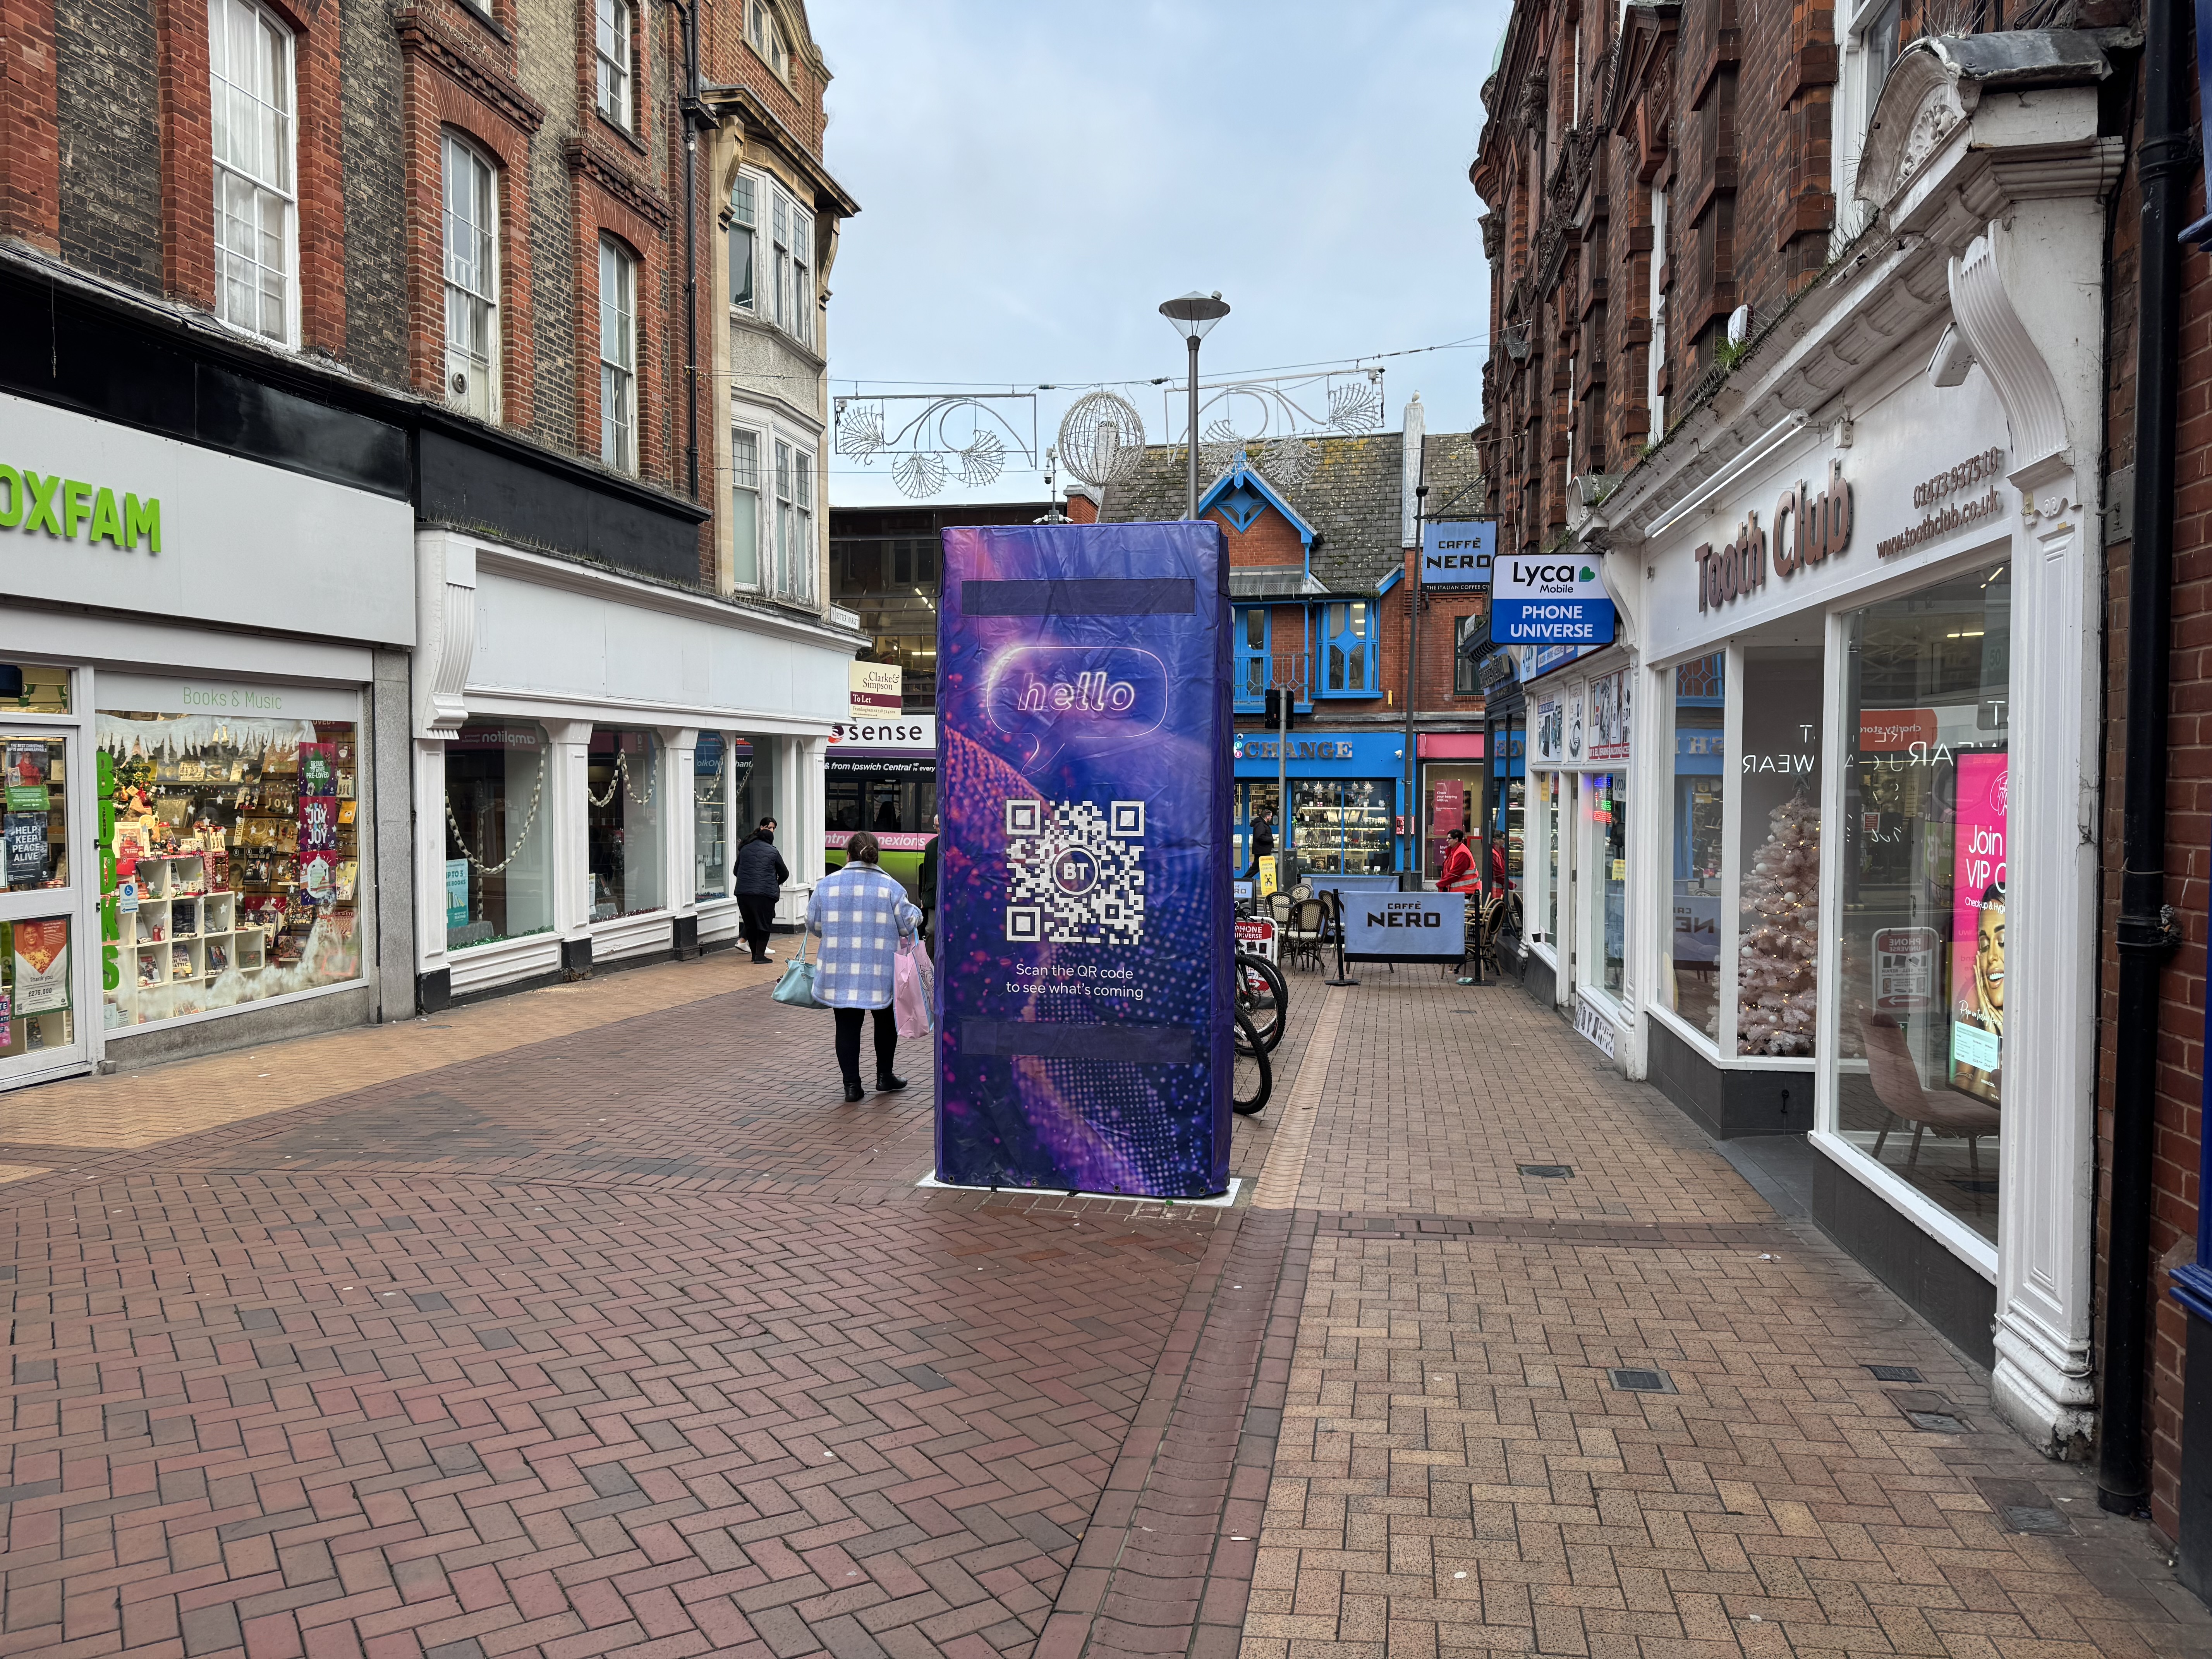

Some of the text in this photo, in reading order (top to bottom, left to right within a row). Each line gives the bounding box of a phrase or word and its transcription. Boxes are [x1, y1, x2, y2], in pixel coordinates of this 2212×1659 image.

[1914, 446, 1997, 509] 01473 937510
[0, 464, 161, 553] OXFAM
[1877, 485, 1997, 559] www.toothclub.co.uk
[1438, 537, 1480, 548] CAFFÈ
[1695, 458, 1848, 613] Tooth Club
[1427, 555, 1491, 570] NERO
[1513, 562, 1575, 587] Lyca
[1540, 584, 1573, 593] Mobile
[1522, 605, 1583, 619] PHONE
[1510, 624, 1593, 638] UNIVERSE
[863, 678, 893, 692] Simpson
[1018, 672, 1135, 711] hello
[183, 687, 282, 709] Books & Music
[853, 694, 871, 703] To Let
[849, 726, 922, 740] sense
[852, 763, 881, 771] Ipswich
[307, 808, 327, 824] JOY
[15, 826, 37, 835] HELP
[307, 828, 328, 844] JOY
[15, 835, 38, 844] KEEP
[878, 834, 925, 847] nexions
[1969, 824, 2002, 856] Join
[12, 843, 40, 853] PEACE
[14, 852, 38, 862] ALIVE
[1063, 863, 1089, 880] BT
[1966, 859, 1990, 889] VIP
[1965, 896, 1988, 910] Check-up
[1367, 912, 1440, 927] NERO
[1016, 963, 1133, 979] Scan the QR code
[1006, 982, 1020, 993] to
[1023, 984, 1046, 994] see
[1094, 987, 1144, 1000] coming
[1959, 1000, 1971, 1020] Pop
